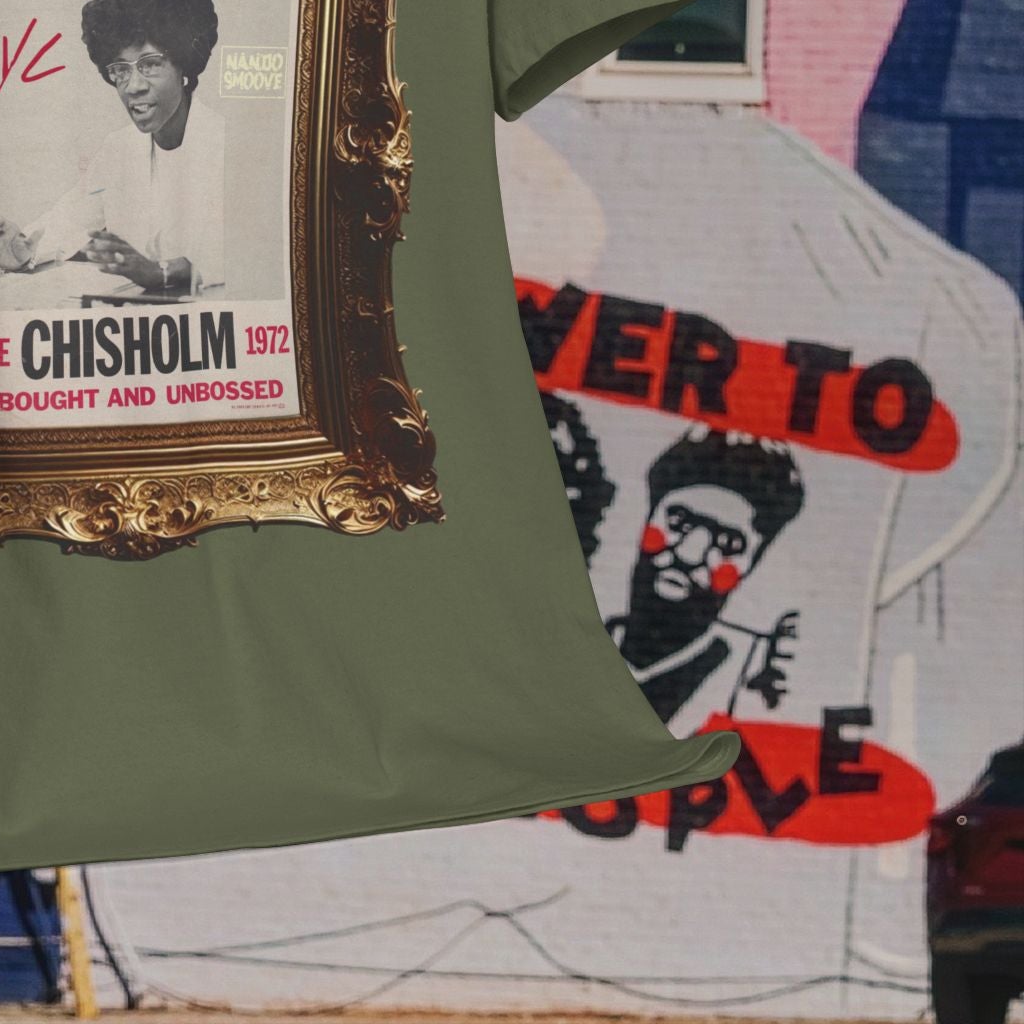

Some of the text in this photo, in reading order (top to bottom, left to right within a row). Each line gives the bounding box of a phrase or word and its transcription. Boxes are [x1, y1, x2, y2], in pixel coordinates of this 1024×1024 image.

[226, 52, 284, 71] NANDO
[223, 71, 283, 90] SMOOVE
[20, 311, 236, 380] CHISHOLM
[244, 325, 290, 356] 1972
[107, 386, 156, 407] AND
[166, 379, 284, 405] UNBOSSED
[784, 339, 933, 454] TO
